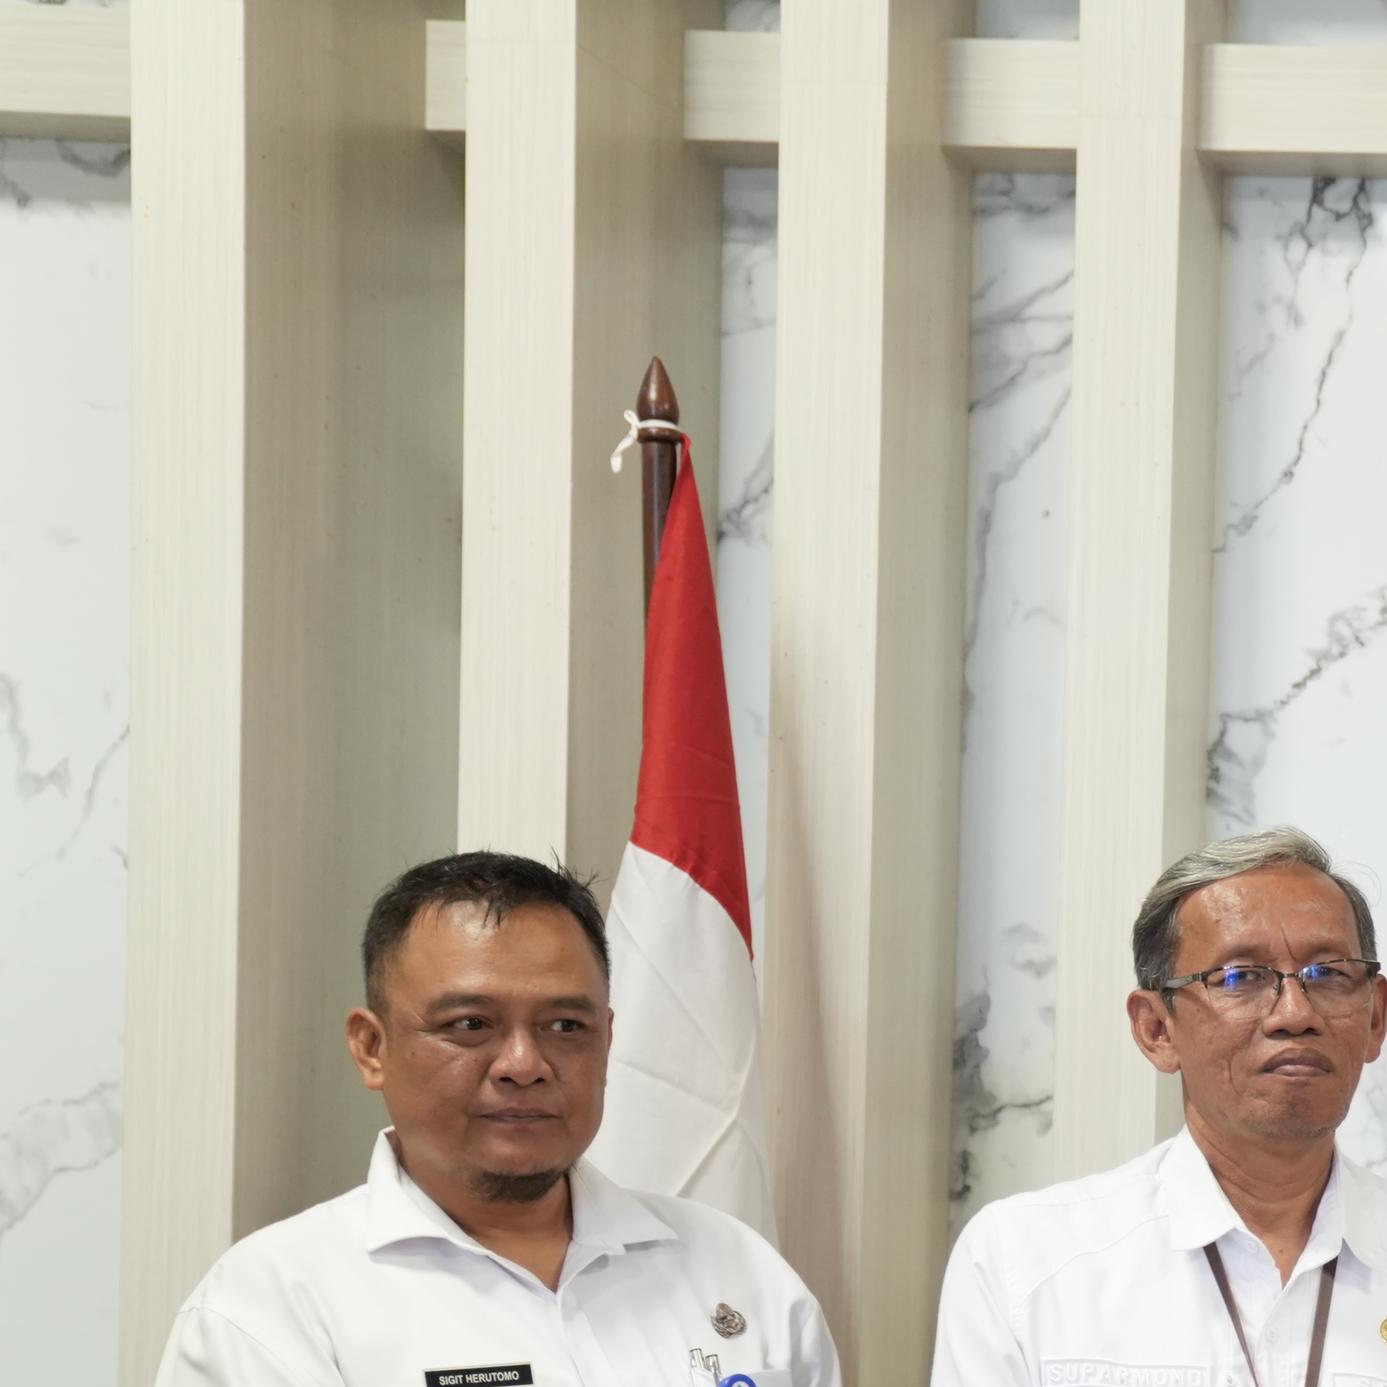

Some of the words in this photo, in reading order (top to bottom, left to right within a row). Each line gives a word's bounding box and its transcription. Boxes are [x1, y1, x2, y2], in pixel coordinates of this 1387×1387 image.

[438, 1373, 463, 1386] SIGIT
[465, 1370, 520, 1384] HERUTOMO
[1047, 1361, 1203, 1387] SUPARMONO
